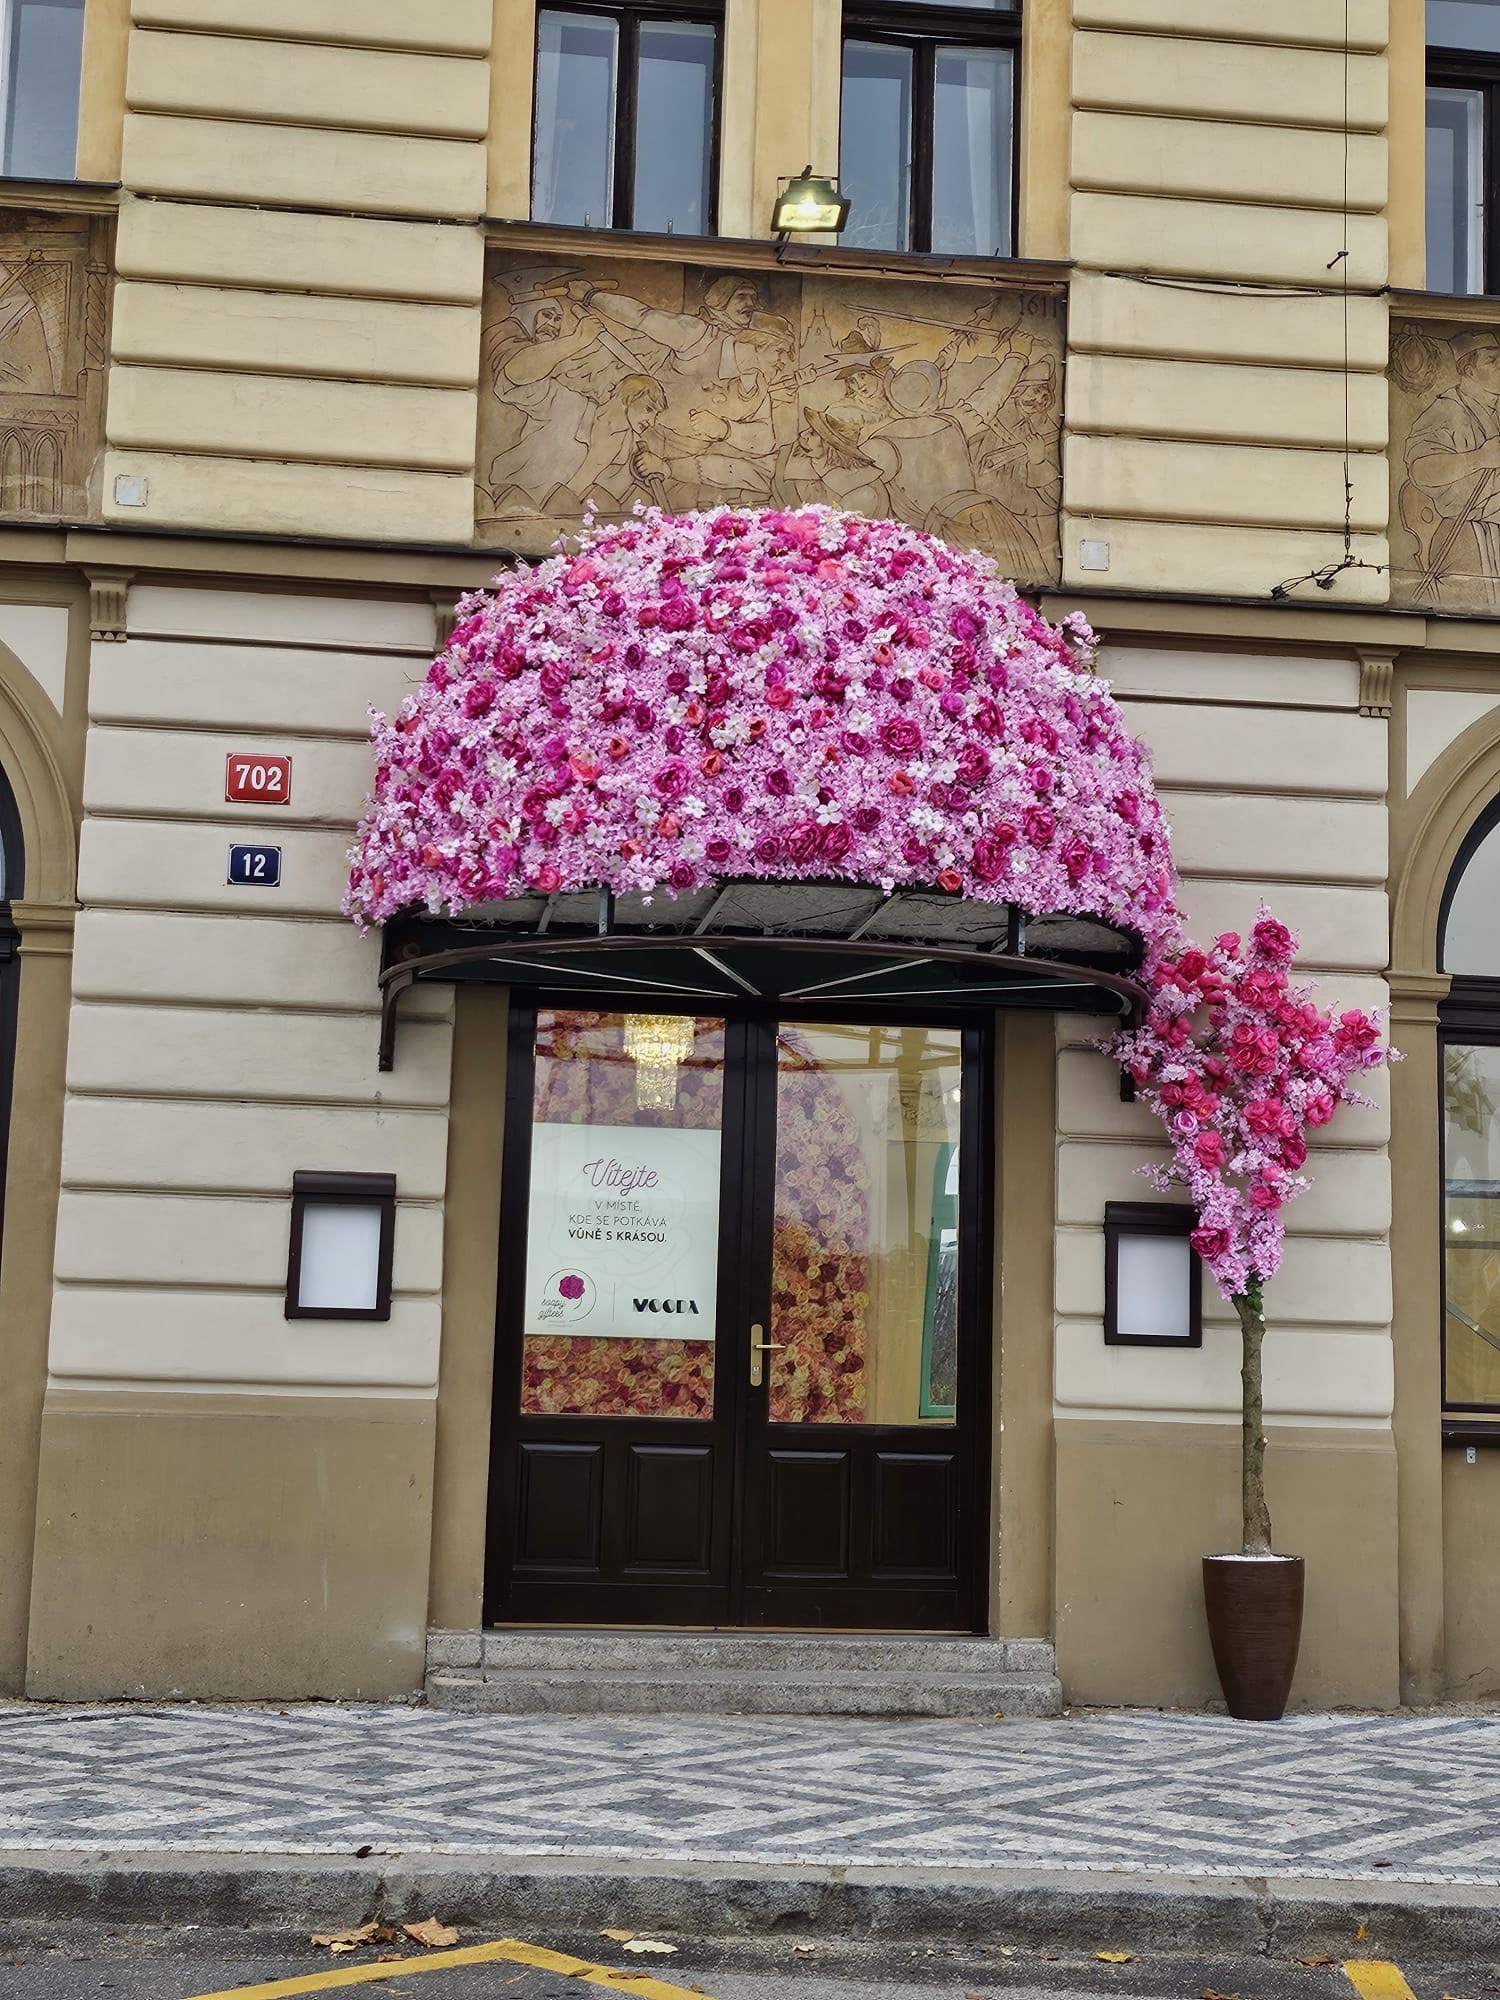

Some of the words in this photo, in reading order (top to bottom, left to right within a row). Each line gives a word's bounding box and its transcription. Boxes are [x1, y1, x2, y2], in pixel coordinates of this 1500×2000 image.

[1019, 293, 1058, 318] 1611
[235, 764, 283, 791] 702
[243, 853, 266, 877] 12
[582, 1158, 659, 1197] Vítejte
[595, 1200, 604, 1210] V
[568, 1214, 592, 1225] KDE
[596, 1215, 610, 1226] SE
[613, 1215, 667, 1227] POTKÁVÁ
[568, 1227, 602, 1240] VŮNĚ
[606, 1230, 613, 1241] S
[616, 1229, 667, 1242] KRÁSOU.
